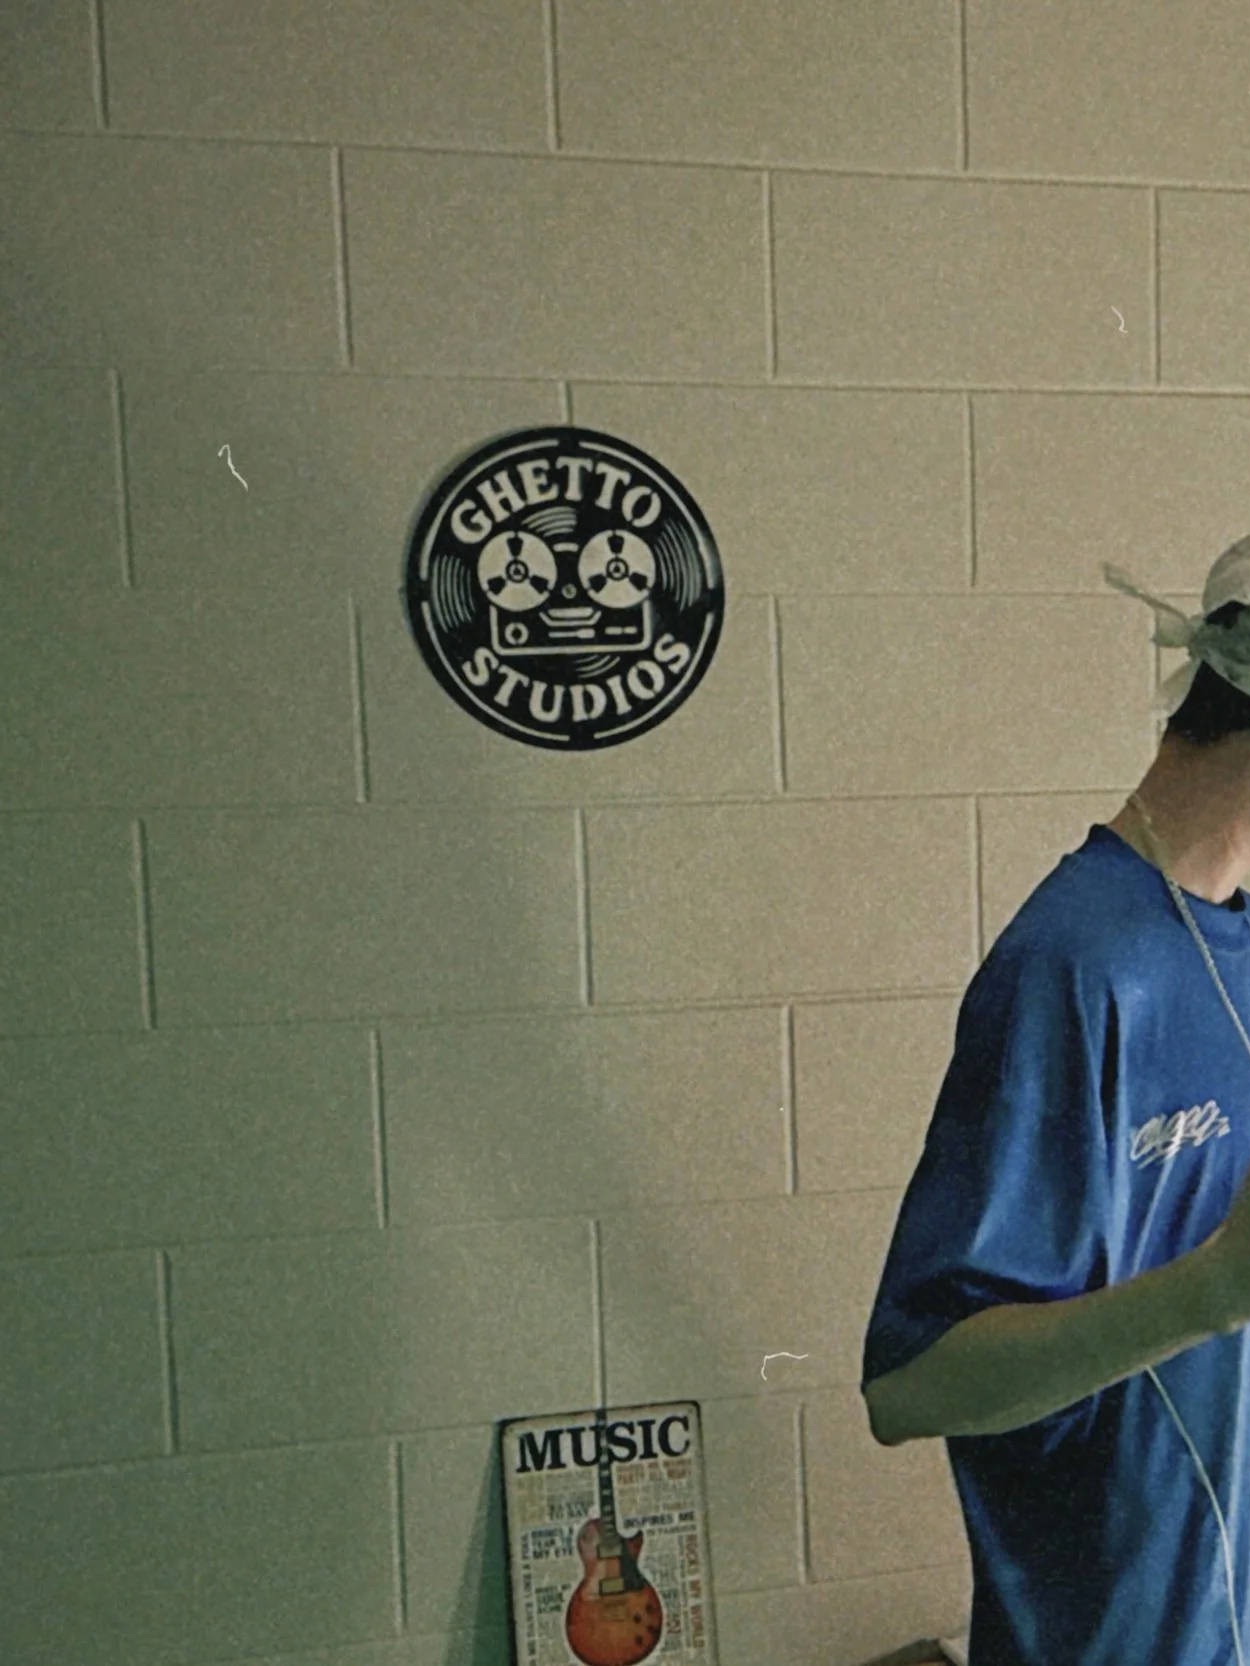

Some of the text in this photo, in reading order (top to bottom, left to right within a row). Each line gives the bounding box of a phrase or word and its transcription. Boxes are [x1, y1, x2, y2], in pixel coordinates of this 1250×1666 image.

[450, 455, 662, 544] GHETTO
[461, 633, 691, 723] STUDIOS
[515, 1415, 692, 1473] MUSIC
